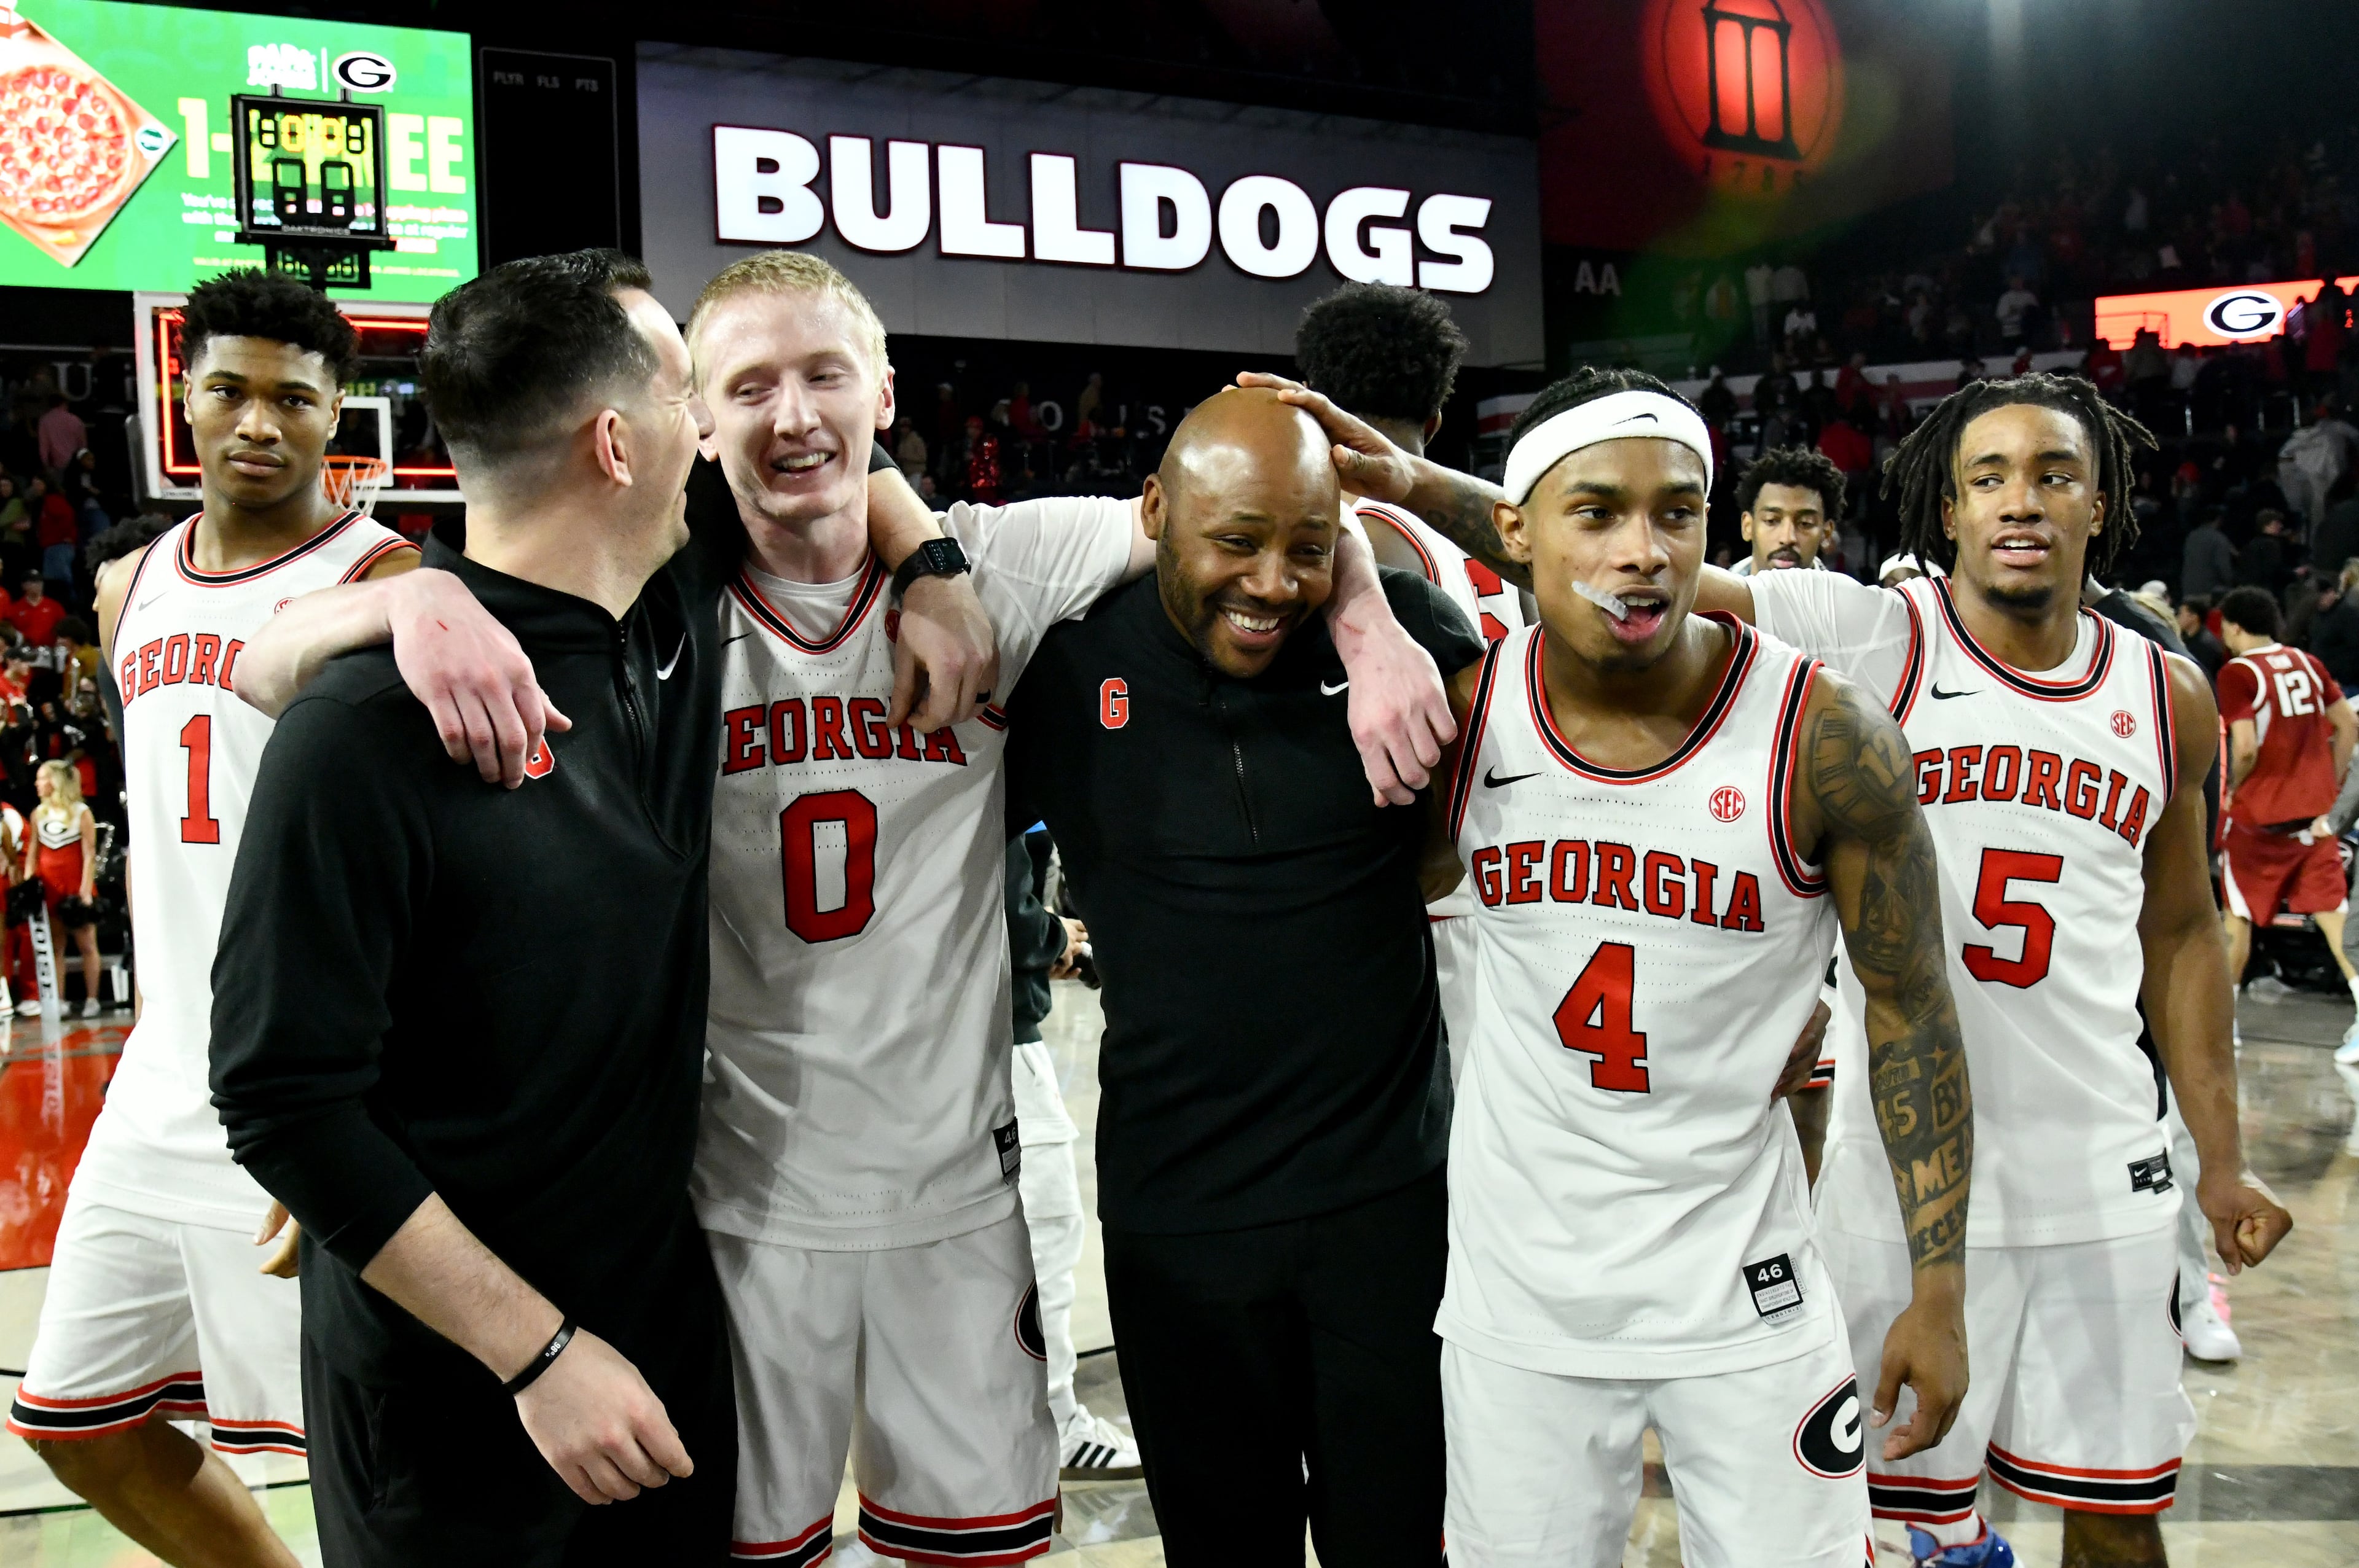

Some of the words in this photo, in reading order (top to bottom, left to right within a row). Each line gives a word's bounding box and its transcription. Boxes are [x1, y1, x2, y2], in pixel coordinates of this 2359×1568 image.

[338, 57, 392, 88] G
[575, 78, 599, 92] PTS
[712, 123, 1495, 294] BULLDOGS
[1574, 260, 1622, 297] AA
[2210, 295, 2277, 333] G
[1100, 677, 1129, 730] G
[2273, 670, 2315, 718] 12
[2113, 712, 2134, 735] SEC
[179, 714, 220, 844] 1
[1713, 789, 1742, 819] SEC
[1912, 744, 2151, 849] GEORGIA
[780, 789, 878, 945] 0
[1471, 839, 1766, 933] GEORGIA
[1961, 847, 2065, 989] 5
[1552, 941, 1651, 1094] 4
[1004, 1126, 1017, 1144] 46
[1757, 1263, 1783, 1282] 46
[1799, 1378, 1864, 1473] G
